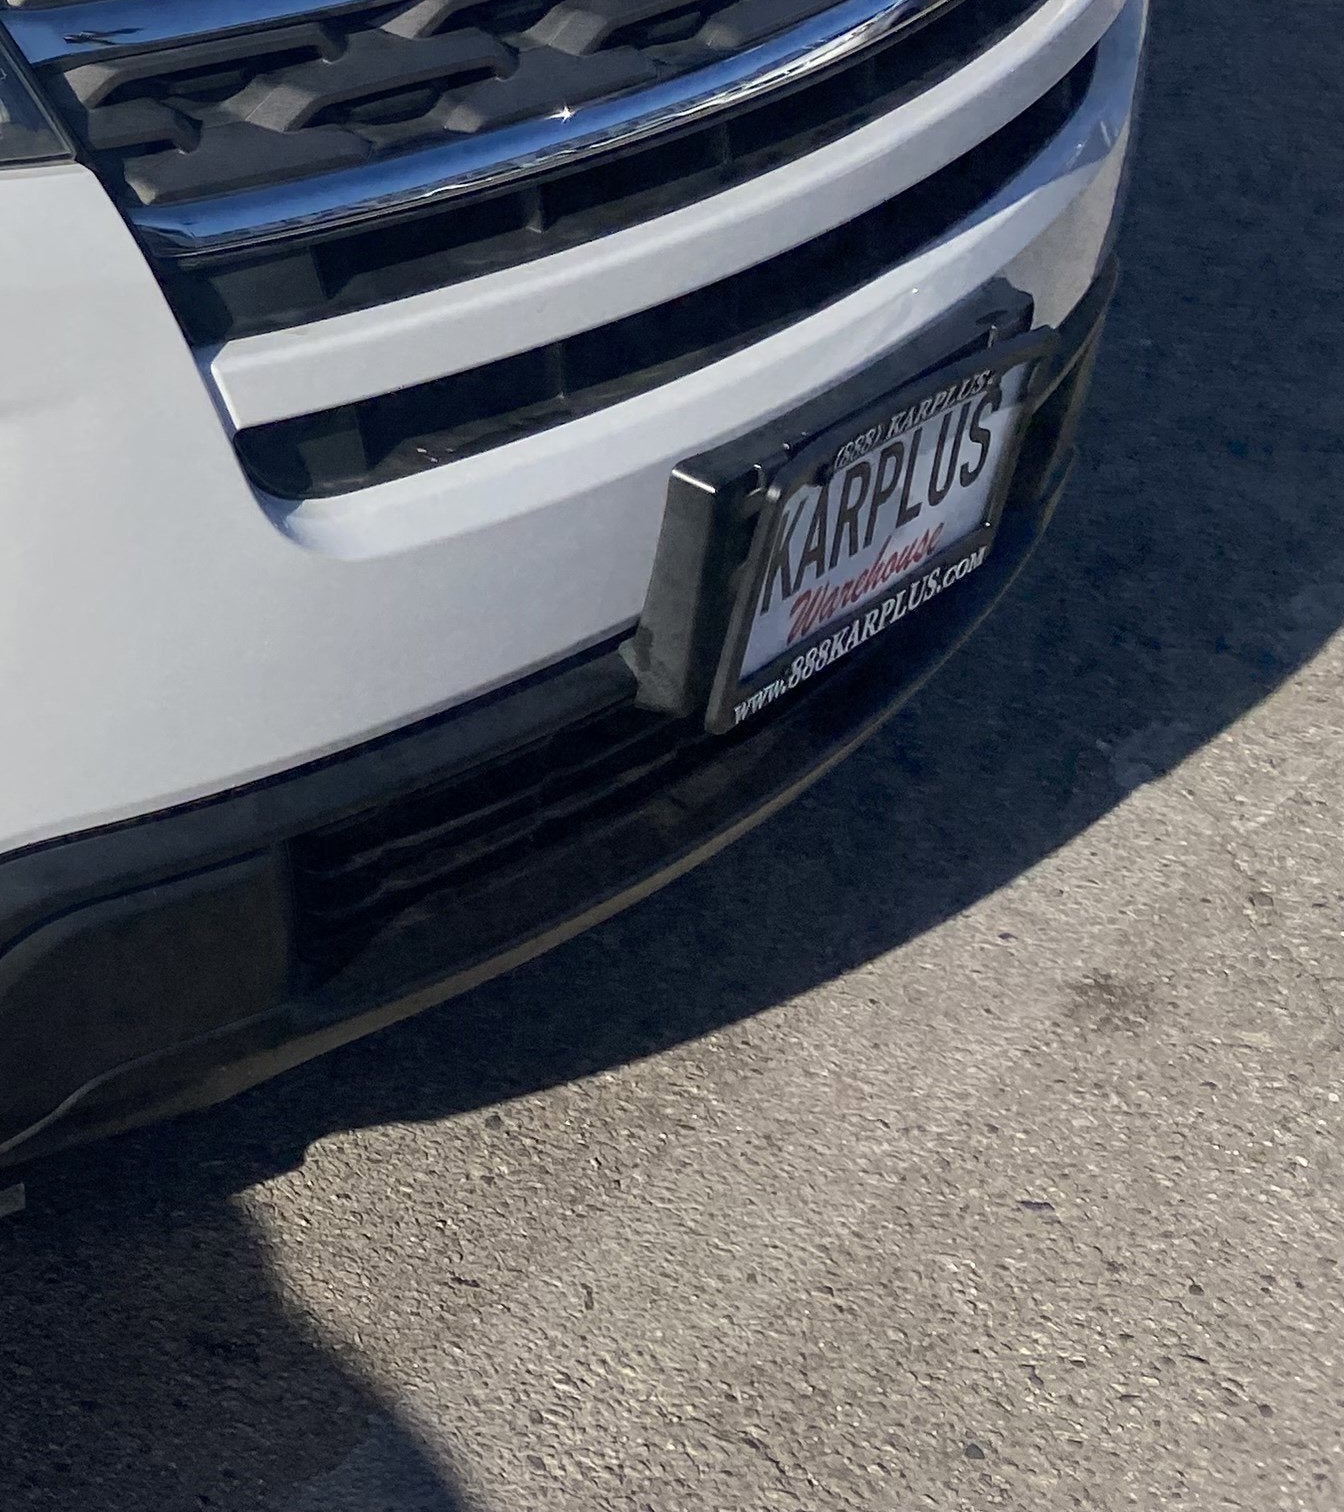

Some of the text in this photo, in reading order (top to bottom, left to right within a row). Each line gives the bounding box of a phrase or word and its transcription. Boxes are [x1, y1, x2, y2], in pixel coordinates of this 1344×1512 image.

[834, 369, 993, 468] (888) KARPLUS
[759, 393, 1000, 616] KARPLUS
[787, 522, 944, 646] Warehouse
